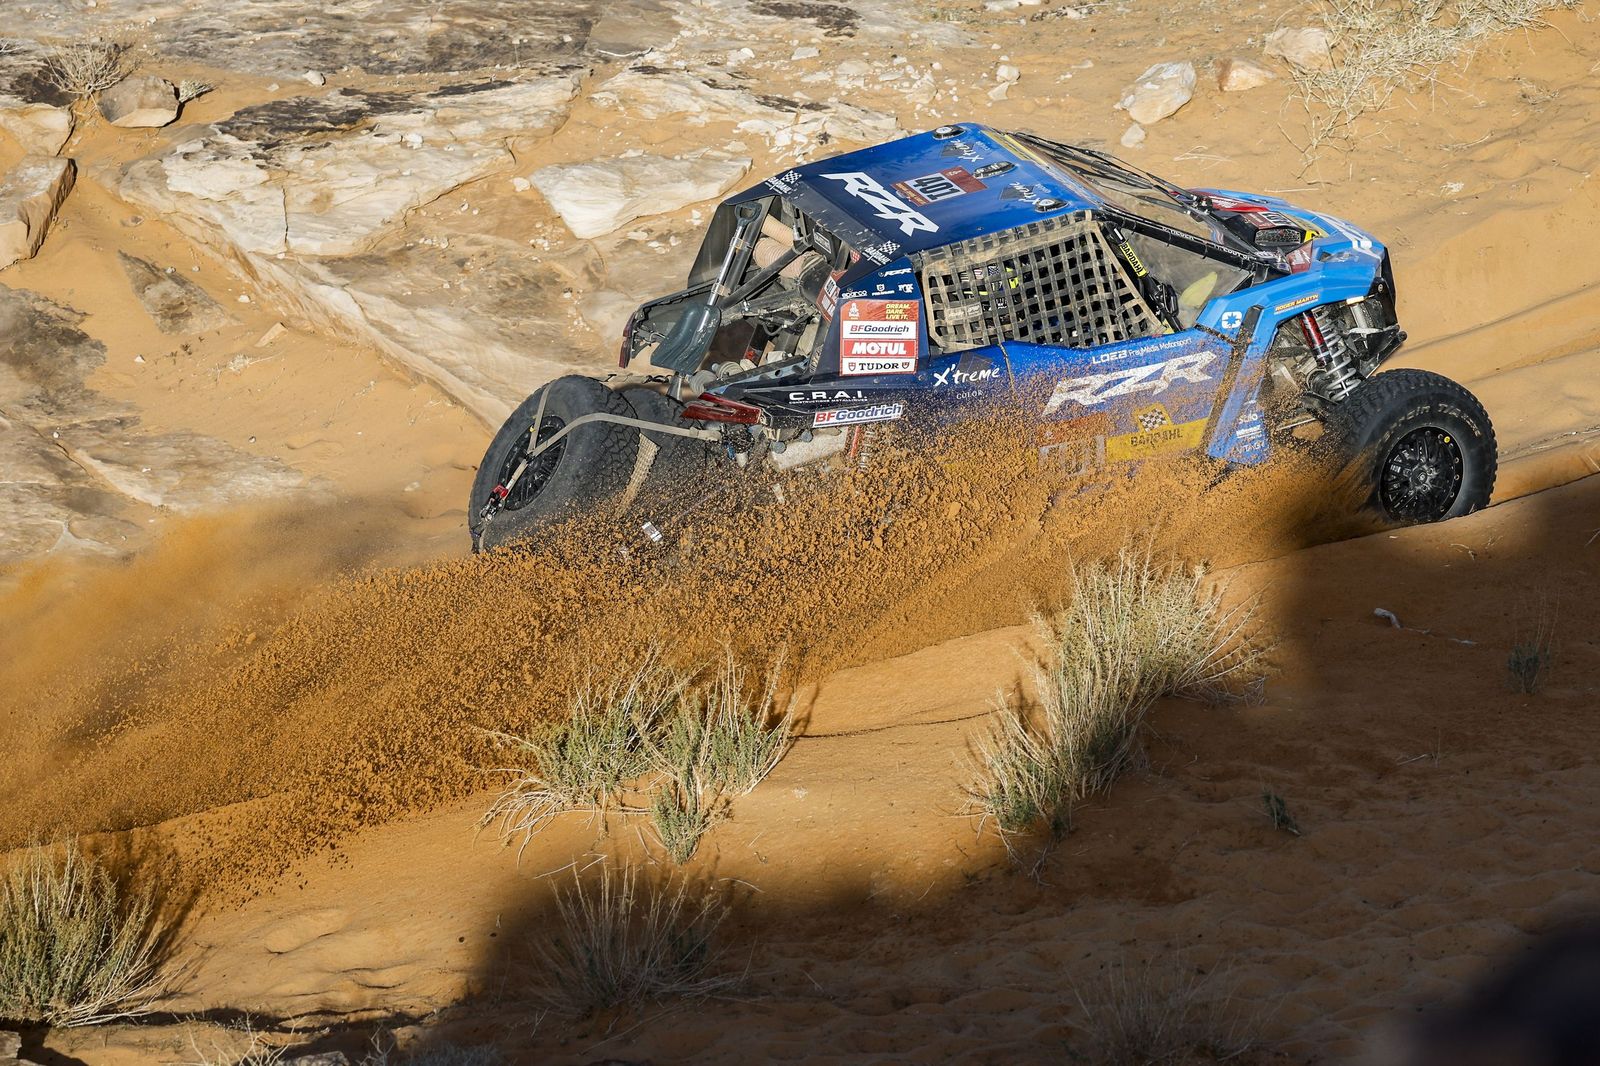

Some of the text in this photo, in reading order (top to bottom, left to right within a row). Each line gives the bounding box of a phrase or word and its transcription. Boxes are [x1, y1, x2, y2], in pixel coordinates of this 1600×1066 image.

[913, 176, 962, 201] 401
[818, 172, 940, 237] RZR
[1119, 241, 1145, 276] BARDAHL
[850, 324, 909, 333] BFGoodrich
[851, 341, 907, 355] MOTUL
[858, 362, 899, 371] TUDOR
[1042, 350, 1217, 418] RZR
[814, 403, 902, 423] BFGoodrich
